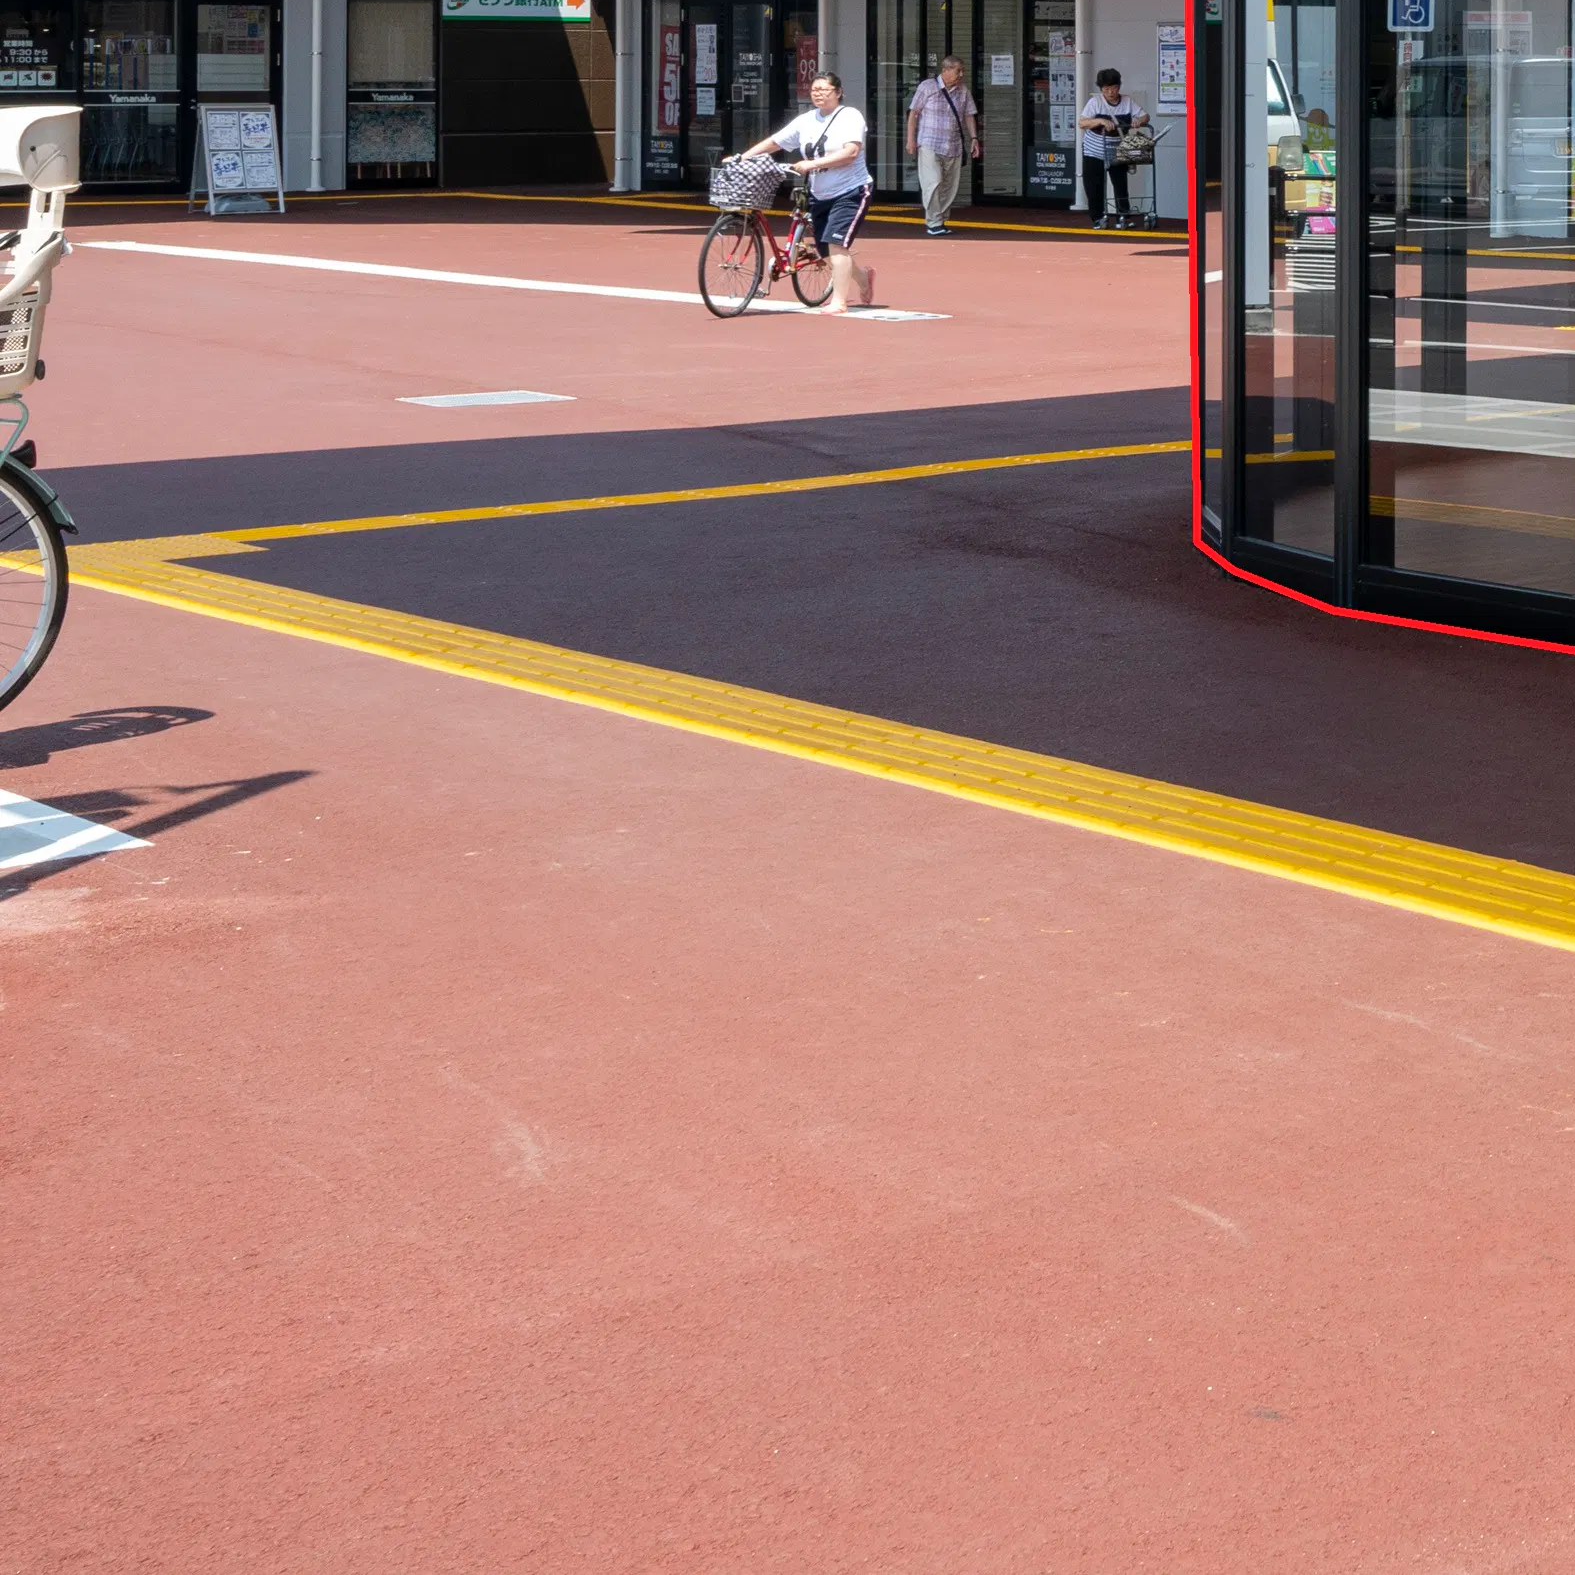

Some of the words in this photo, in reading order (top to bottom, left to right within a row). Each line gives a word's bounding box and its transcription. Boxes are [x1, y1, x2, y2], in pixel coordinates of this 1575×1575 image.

[9, 48, 32, 56] 9:30
[4, 56, 33, 64] 11:00
[33, 56, 49, 64] まで
[109, 93, 157, 103] Yamanaka
[371, 92, 415, 102] Yamanaka
